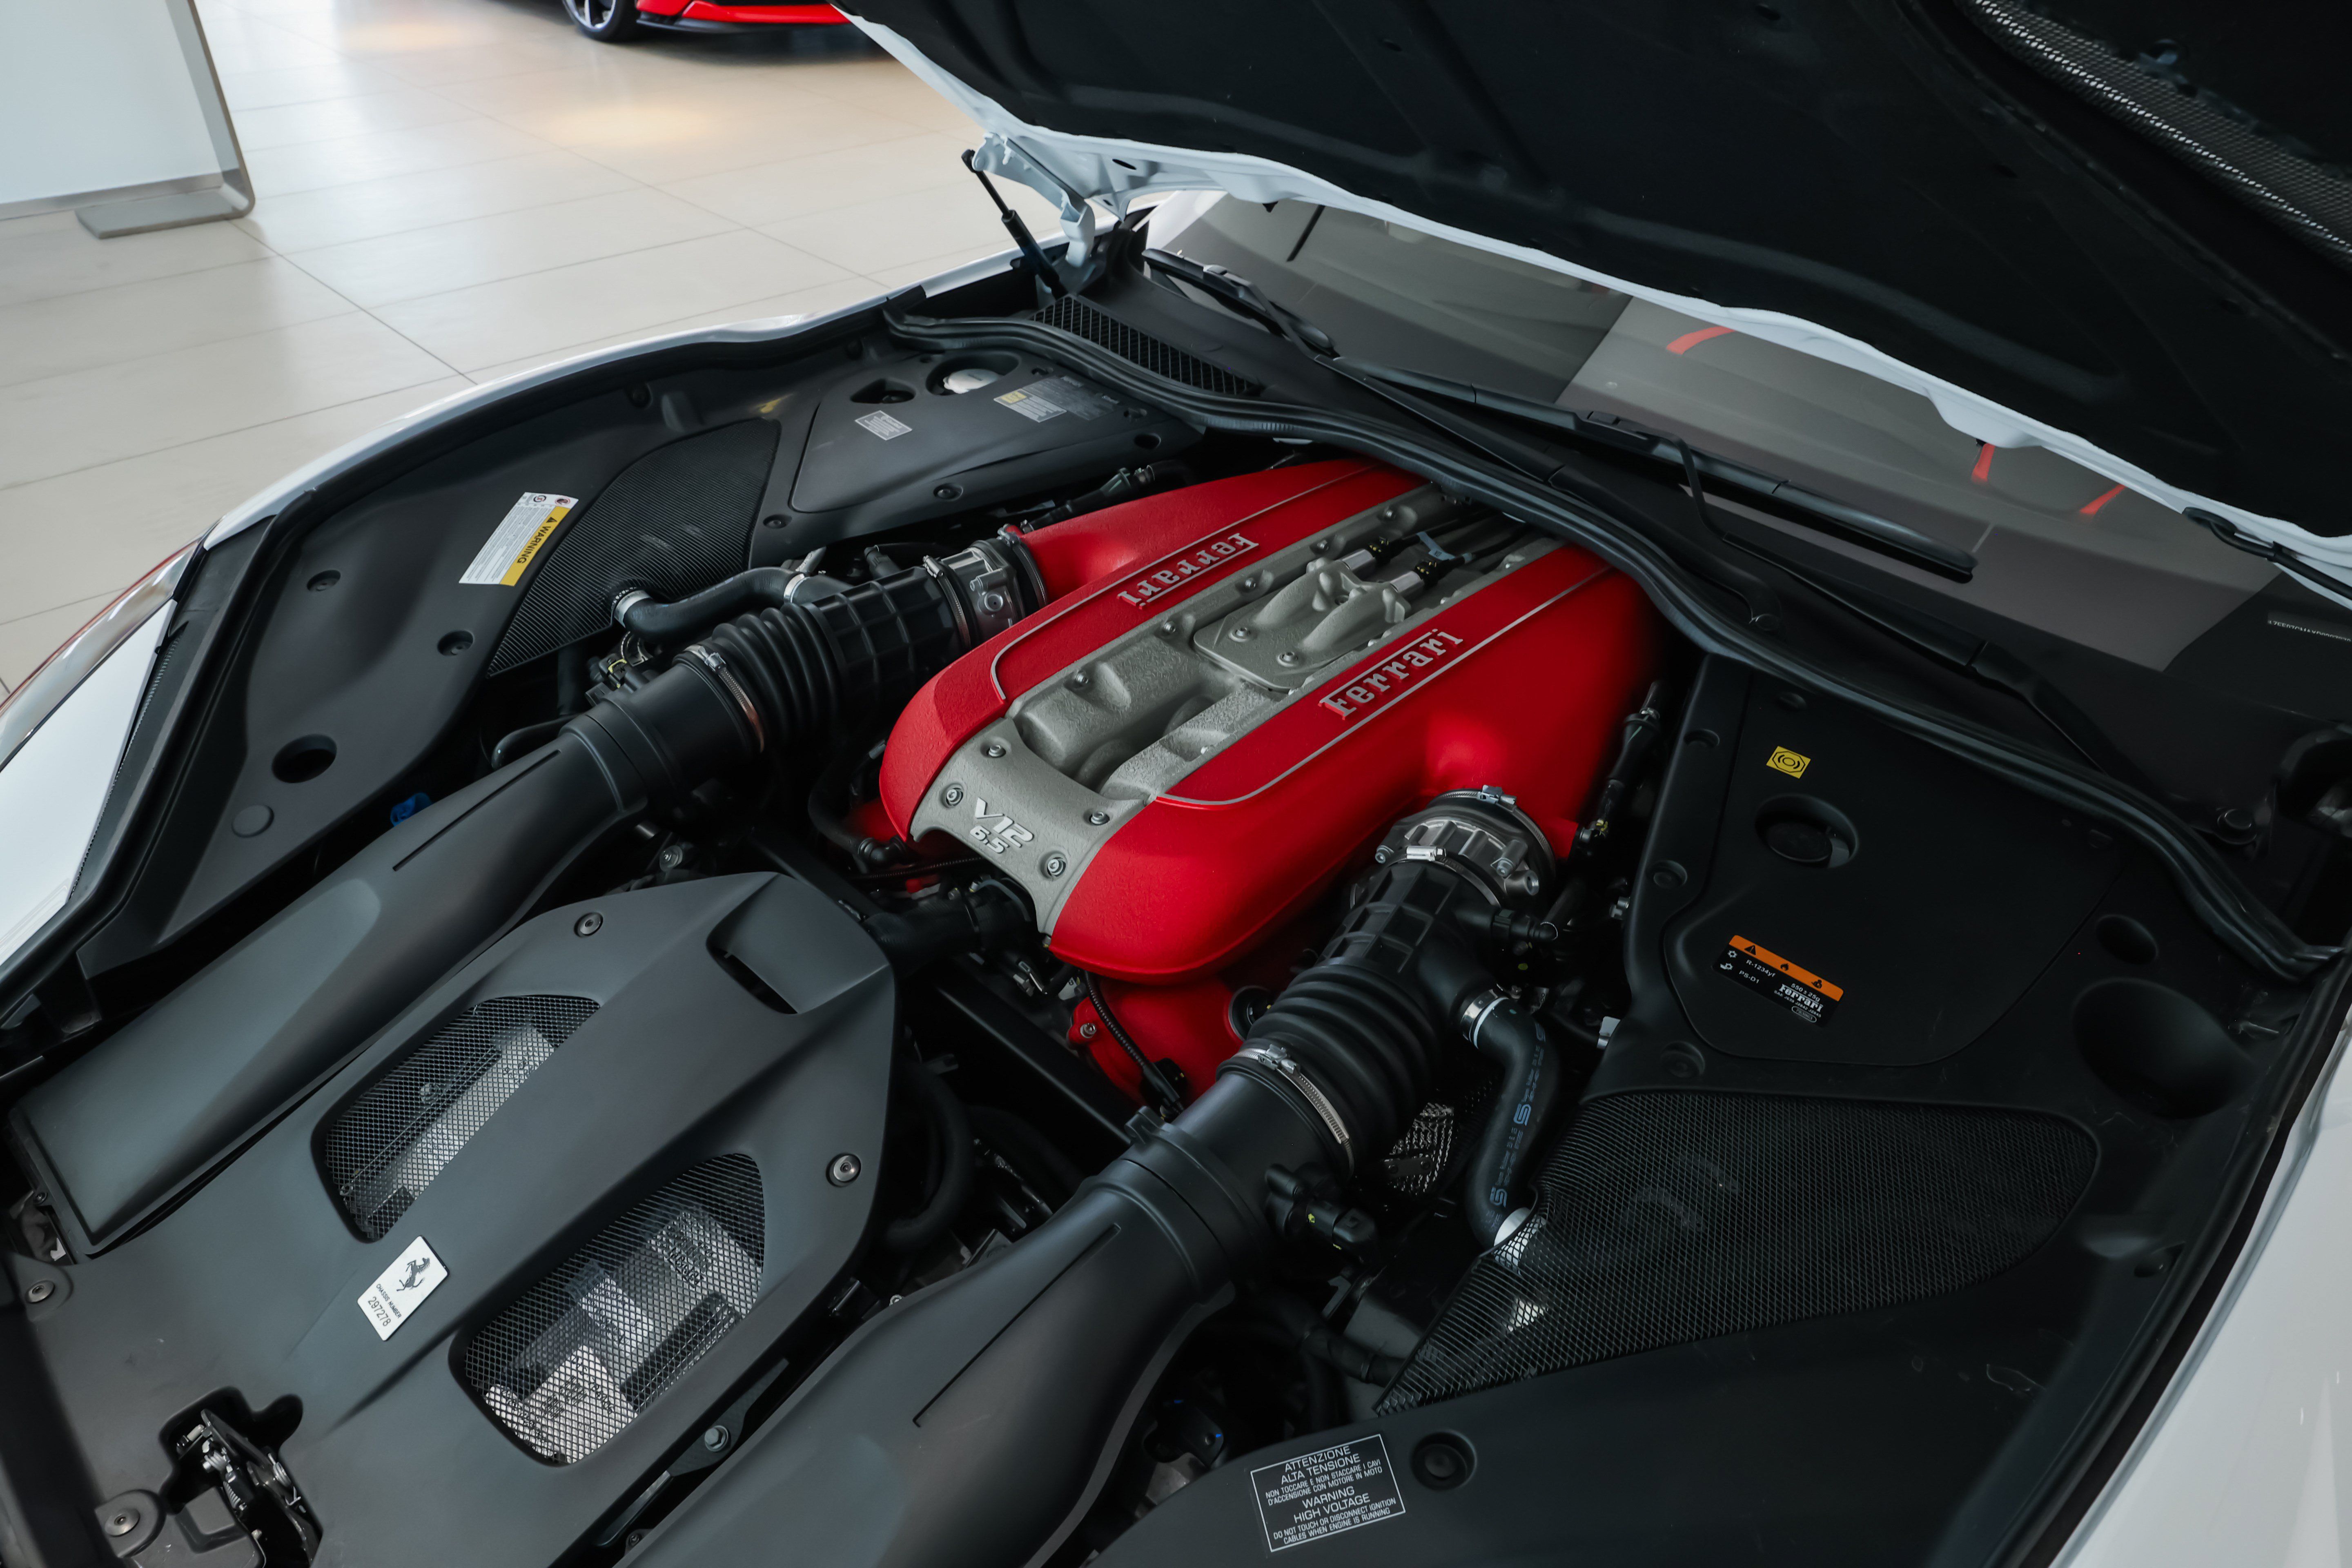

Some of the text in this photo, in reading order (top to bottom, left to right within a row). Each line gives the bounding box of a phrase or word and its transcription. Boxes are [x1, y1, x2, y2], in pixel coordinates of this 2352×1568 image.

[517, 526, 551, 564] WARNING
[1117, 533, 1259, 610] Ferrari
[1319, 628, 1463, 720] Ferrari
[975, 797, 1034, 848] V12
[1739, 970, 1760, 984] PS-D1
[1746, 960, 1776, 978] R-1234yf
[1779, 984, 1824, 1012] Ferrari
[368, 1296, 391, 1327] 297278
[376, 1284, 401, 1319] CHASSIS NUMBER
[1281, 1453, 1361, 1485] ALTA TENSIONE
[1285, 1446, 1351, 1472] ATTENZIONE
[1266, 1489, 1280, 1499] NON
[1281, 1481, 1308, 1494] TOCCARE
[1316, 1474, 1330, 1483] NON
[1331, 1464, 1362, 1479] STACCARE
[1367, 1459, 1381, 1468] CAVI
[1268, 1467, 1382, 1506] D'ACCENSIONE CON MOTORE IN MOTO
[1294, 1493, 1370, 1523] HIGH VOLTAGE
[1302, 1486, 1355, 1509] WARNING
[1274, 1497, 1396, 1540] DO NOT TOUCH OR DISCONNECT IGNITION
[1283, 1532, 1307, 1544] CABLES
[1308, 1526, 1327, 1537] WHEN
[1330, 1519, 1352, 1532] ENGINE
[1362, 1508, 1390, 1521] RUNNING
